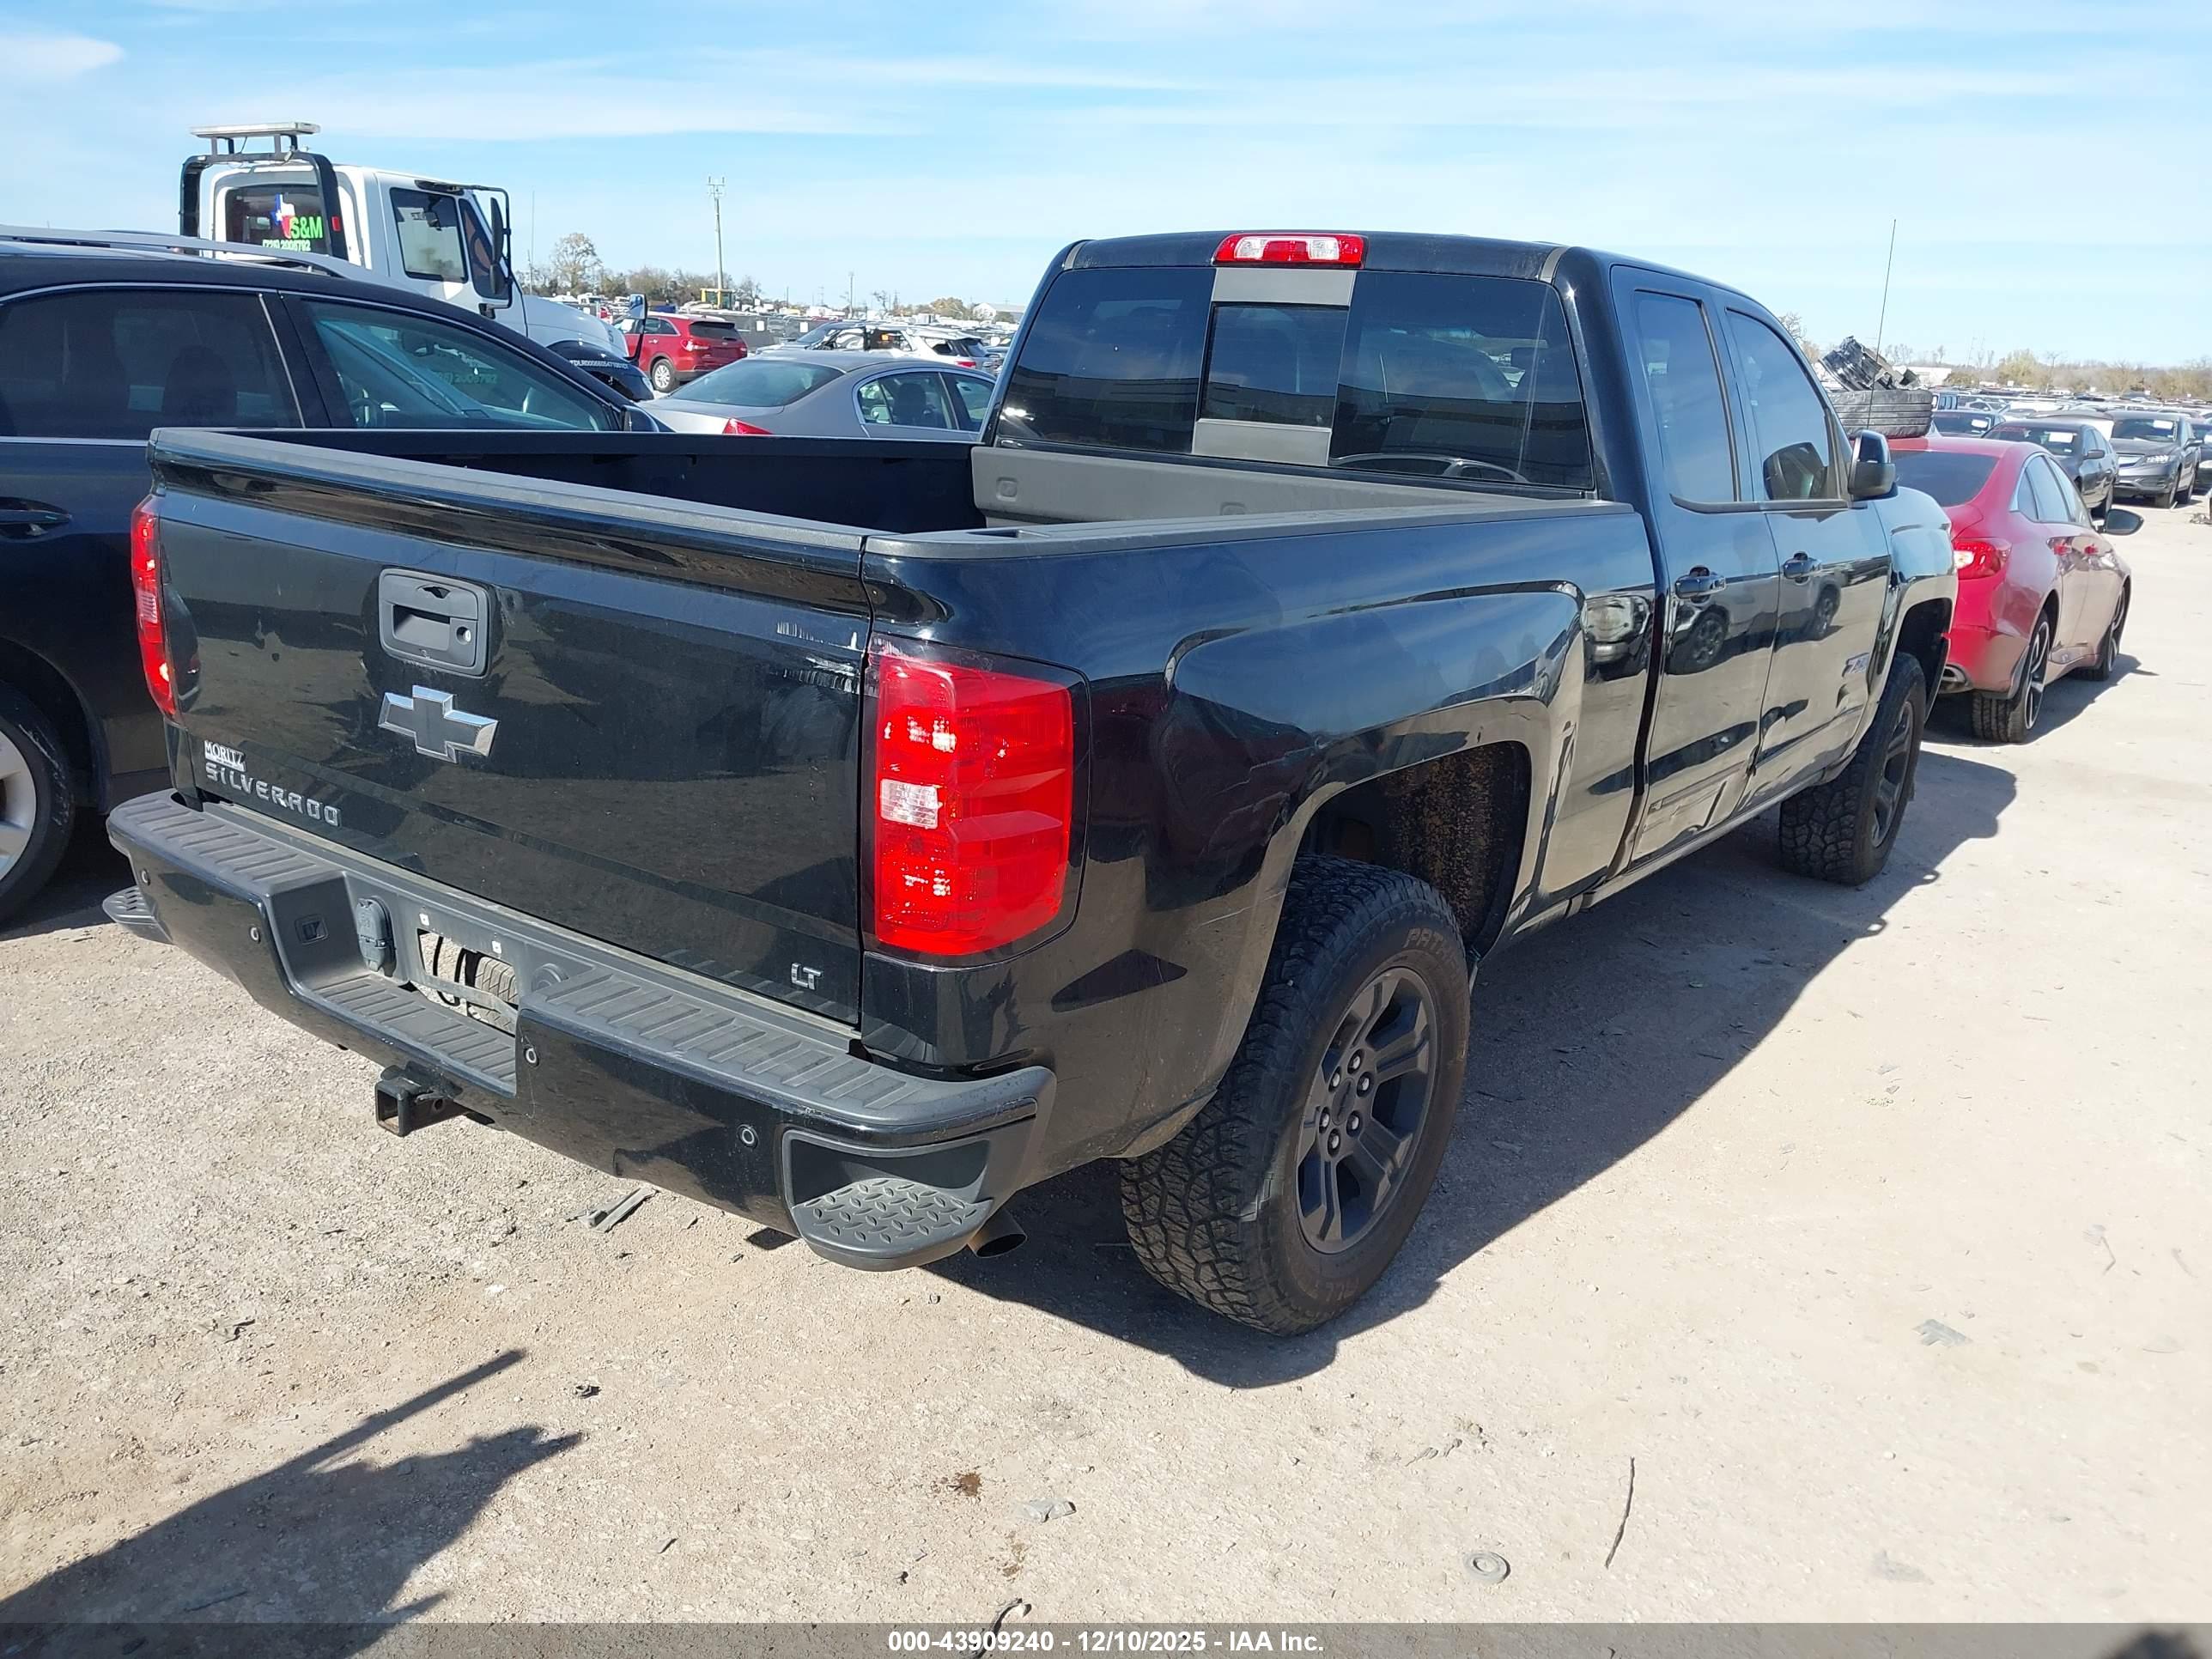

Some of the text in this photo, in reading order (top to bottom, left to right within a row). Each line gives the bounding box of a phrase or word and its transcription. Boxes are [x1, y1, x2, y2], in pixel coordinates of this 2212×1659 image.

[290, 216, 323, 239] S&M
[204, 739, 245, 766] MORITZ
[205, 761, 341, 827] SILVERADO
[791, 962, 823, 990] LT
